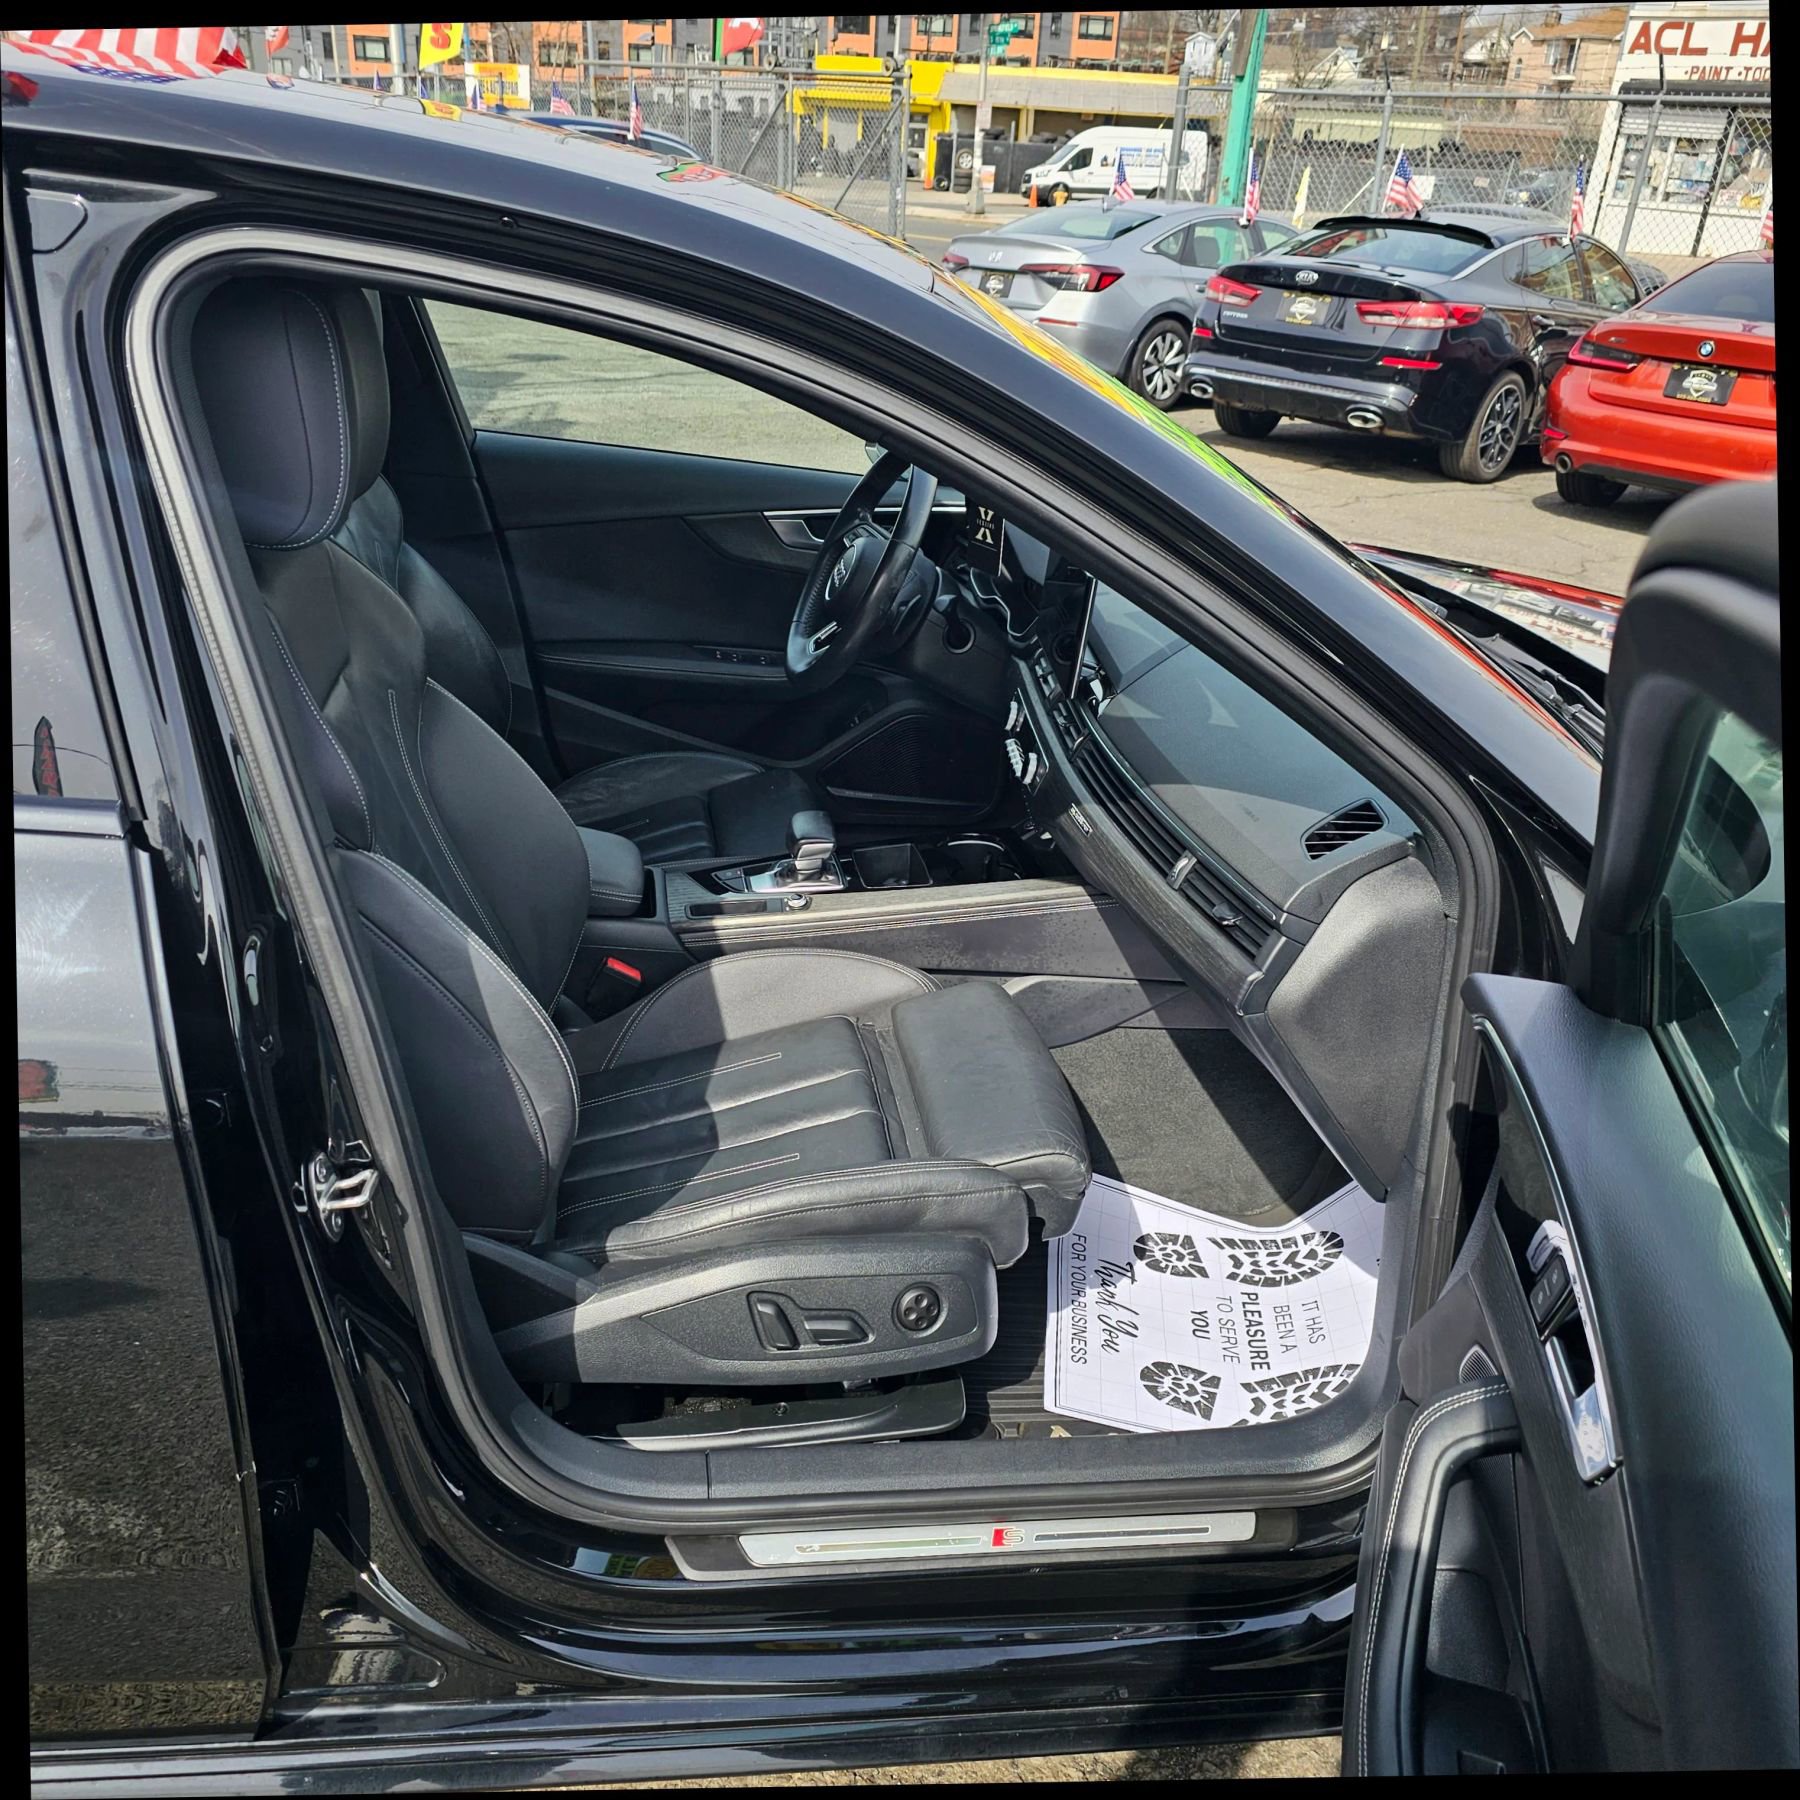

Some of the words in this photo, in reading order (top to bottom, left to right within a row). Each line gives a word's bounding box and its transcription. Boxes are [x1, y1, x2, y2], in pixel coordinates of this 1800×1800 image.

[1628, 21, 1709, 56] ACL
[1729, 22, 1770, 57] H
[1071, 1233, 1087, 1262] FOR
[1071, 1265, 1086, 1298] YOUR
[1094, 1258, 1140, 1316] Thank
[1216, 1295, 1234, 1313] TO
[1301, 1300, 1320, 1312] IT
[1071, 1299, 1088, 1365] BUSINESS
[1097, 1314, 1139, 1355] You
[1190, 1310, 1211, 1340] YOU
[1240, 1291, 1271, 1371] PLEASURE
[1273, 1304, 1296, 1340] BEEN
[1305, 1316, 1326, 1344] HAS
[1218, 1317, 1241, 1364] SERVE
[1280, 1344, 1298, 1354] A
